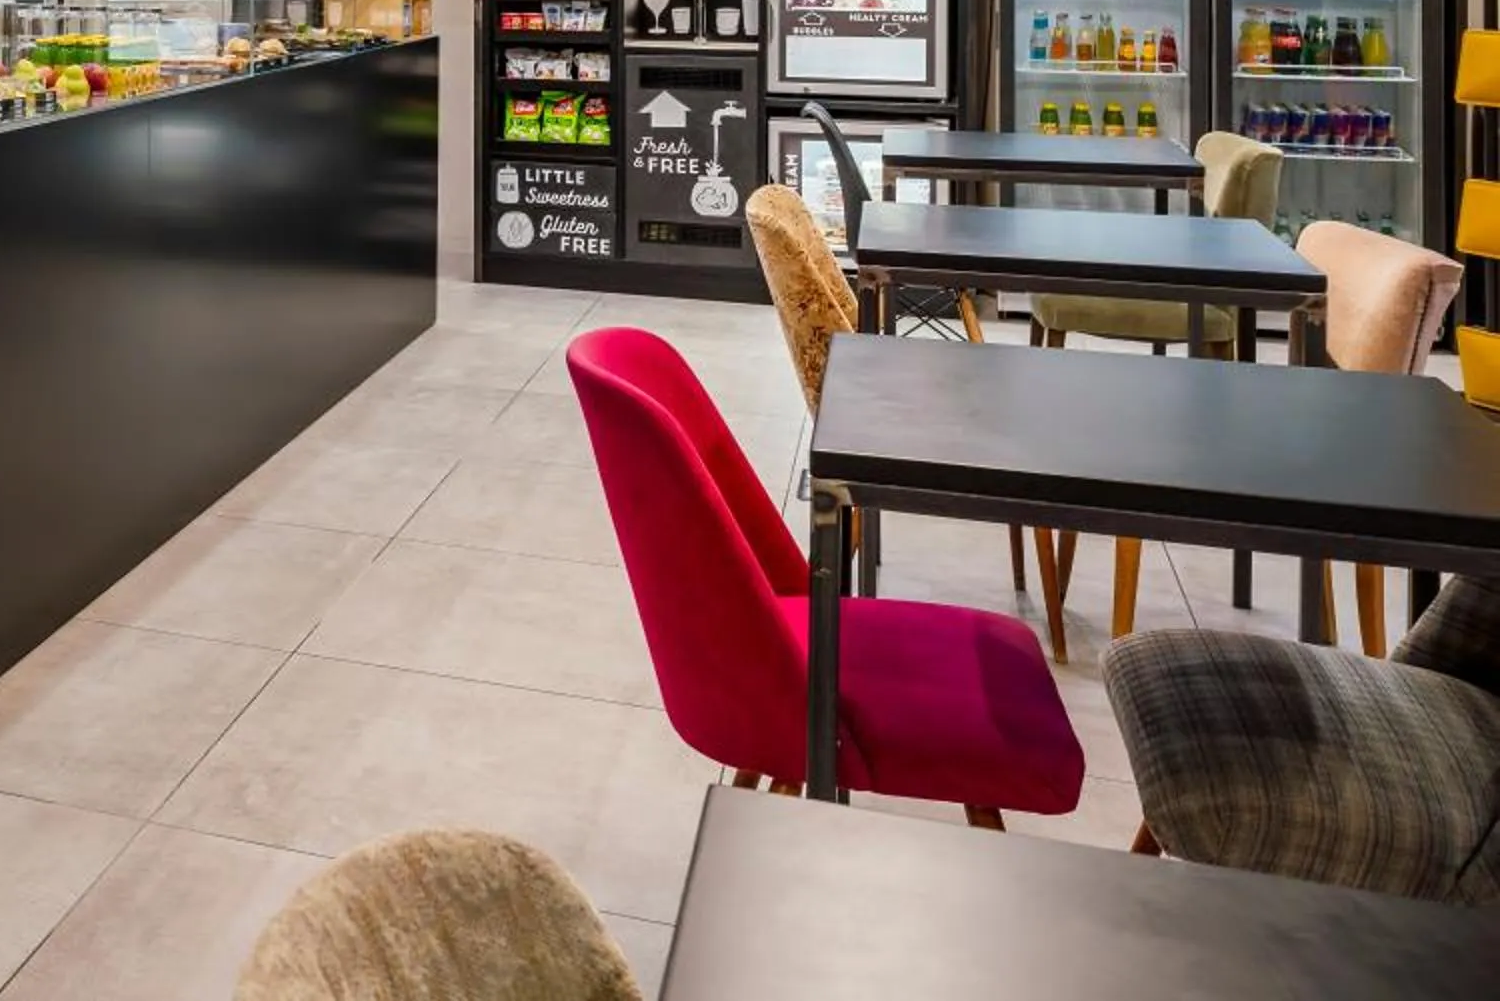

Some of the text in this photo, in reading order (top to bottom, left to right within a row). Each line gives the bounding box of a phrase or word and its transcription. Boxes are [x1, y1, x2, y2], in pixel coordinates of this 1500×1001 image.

[891, 14, 928, 23] CREAM
[633, 137, 692, 155] Fresh
[633, 156, 699, 174] & FREE
[525, 168, 585, 185] LITTLE
[525, 187, 610, 209] Sweetness
[540, 214, 600, 239] Gluten
[560, 236, 611, 255] FREE
